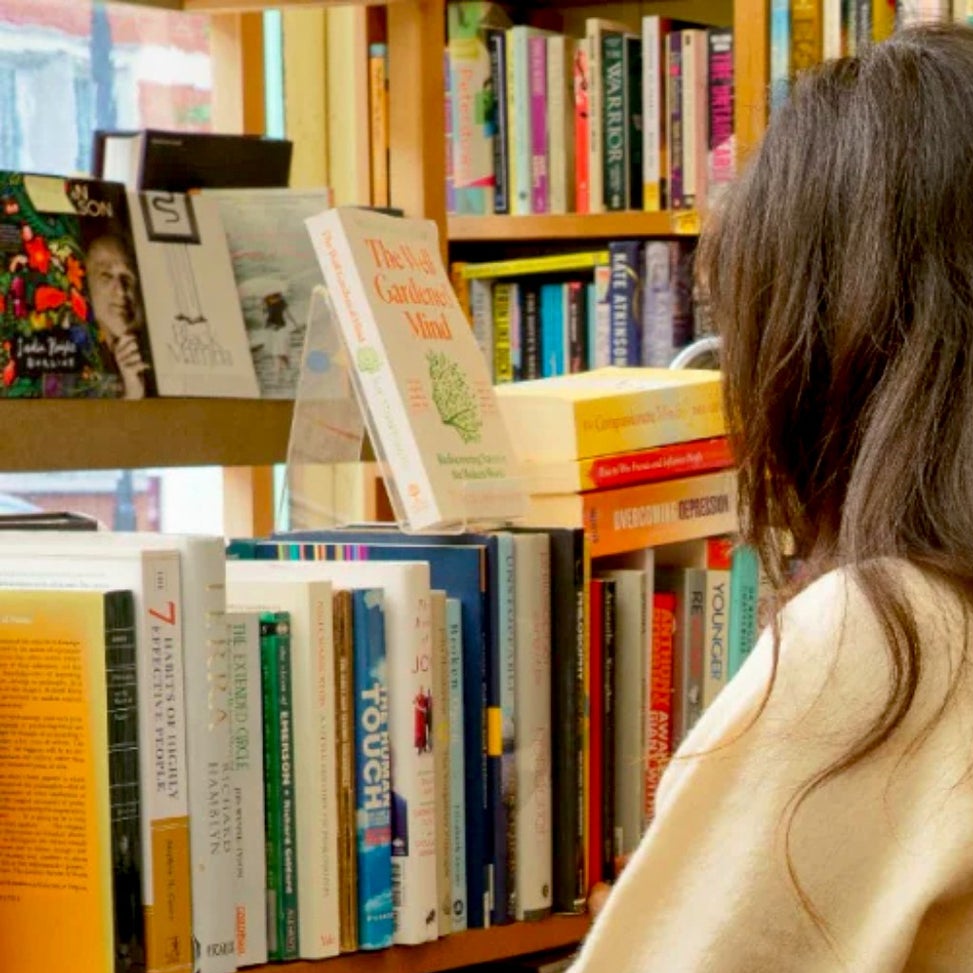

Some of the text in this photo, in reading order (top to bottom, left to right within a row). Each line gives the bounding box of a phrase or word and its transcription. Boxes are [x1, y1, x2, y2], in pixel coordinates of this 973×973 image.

[606, 60, 623, 163] WARRIOR
[365, 238, 403, 271] The
[613, 252, 628, 288] KATE
[677, 494, 729, 520] DEPRESSION
[148, 600, 176, 626] 7
[150, 625, 167, 794] EFFECTIVE PEOPLE
[163, 636, 180, 800] HABITS OF HIGHLY
[361, 682, 382, 812] TOUCH
[279, 710, 291, 786] EMERSON
